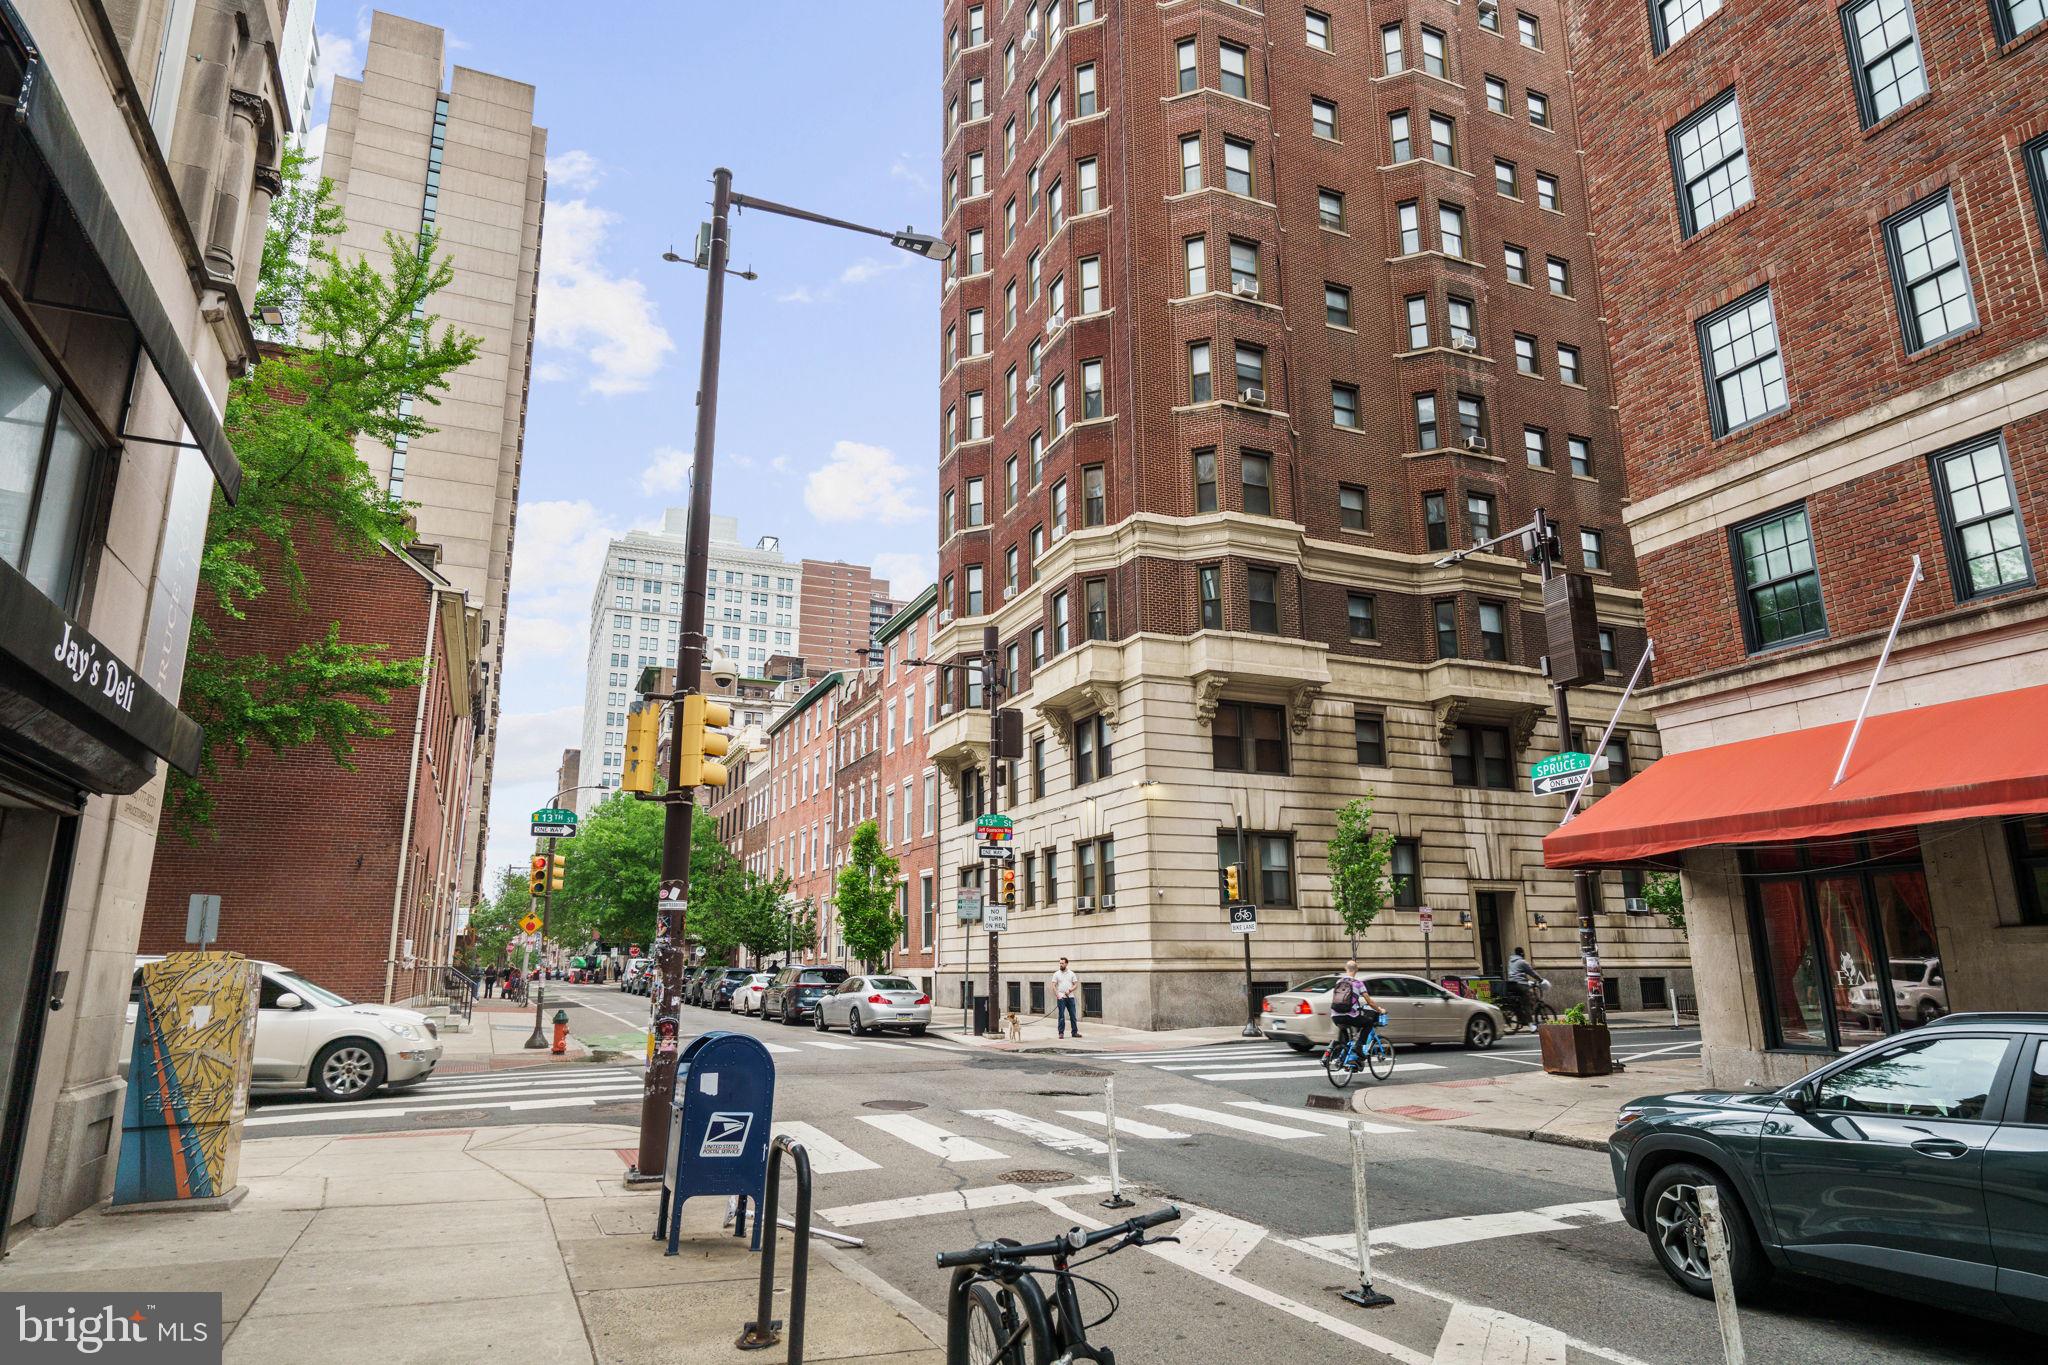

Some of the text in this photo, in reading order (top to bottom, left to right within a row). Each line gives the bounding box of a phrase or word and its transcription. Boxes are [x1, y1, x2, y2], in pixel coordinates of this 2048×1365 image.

[55, 621, 135, 712] Jay's Deli
[1536, 758, 1577, 777] SPRUCE
[1579, 759, 1586, 768] ST
[1550, 774, 1585, 788] ONE WAY
[542, 813, 564, 823] 13TH
